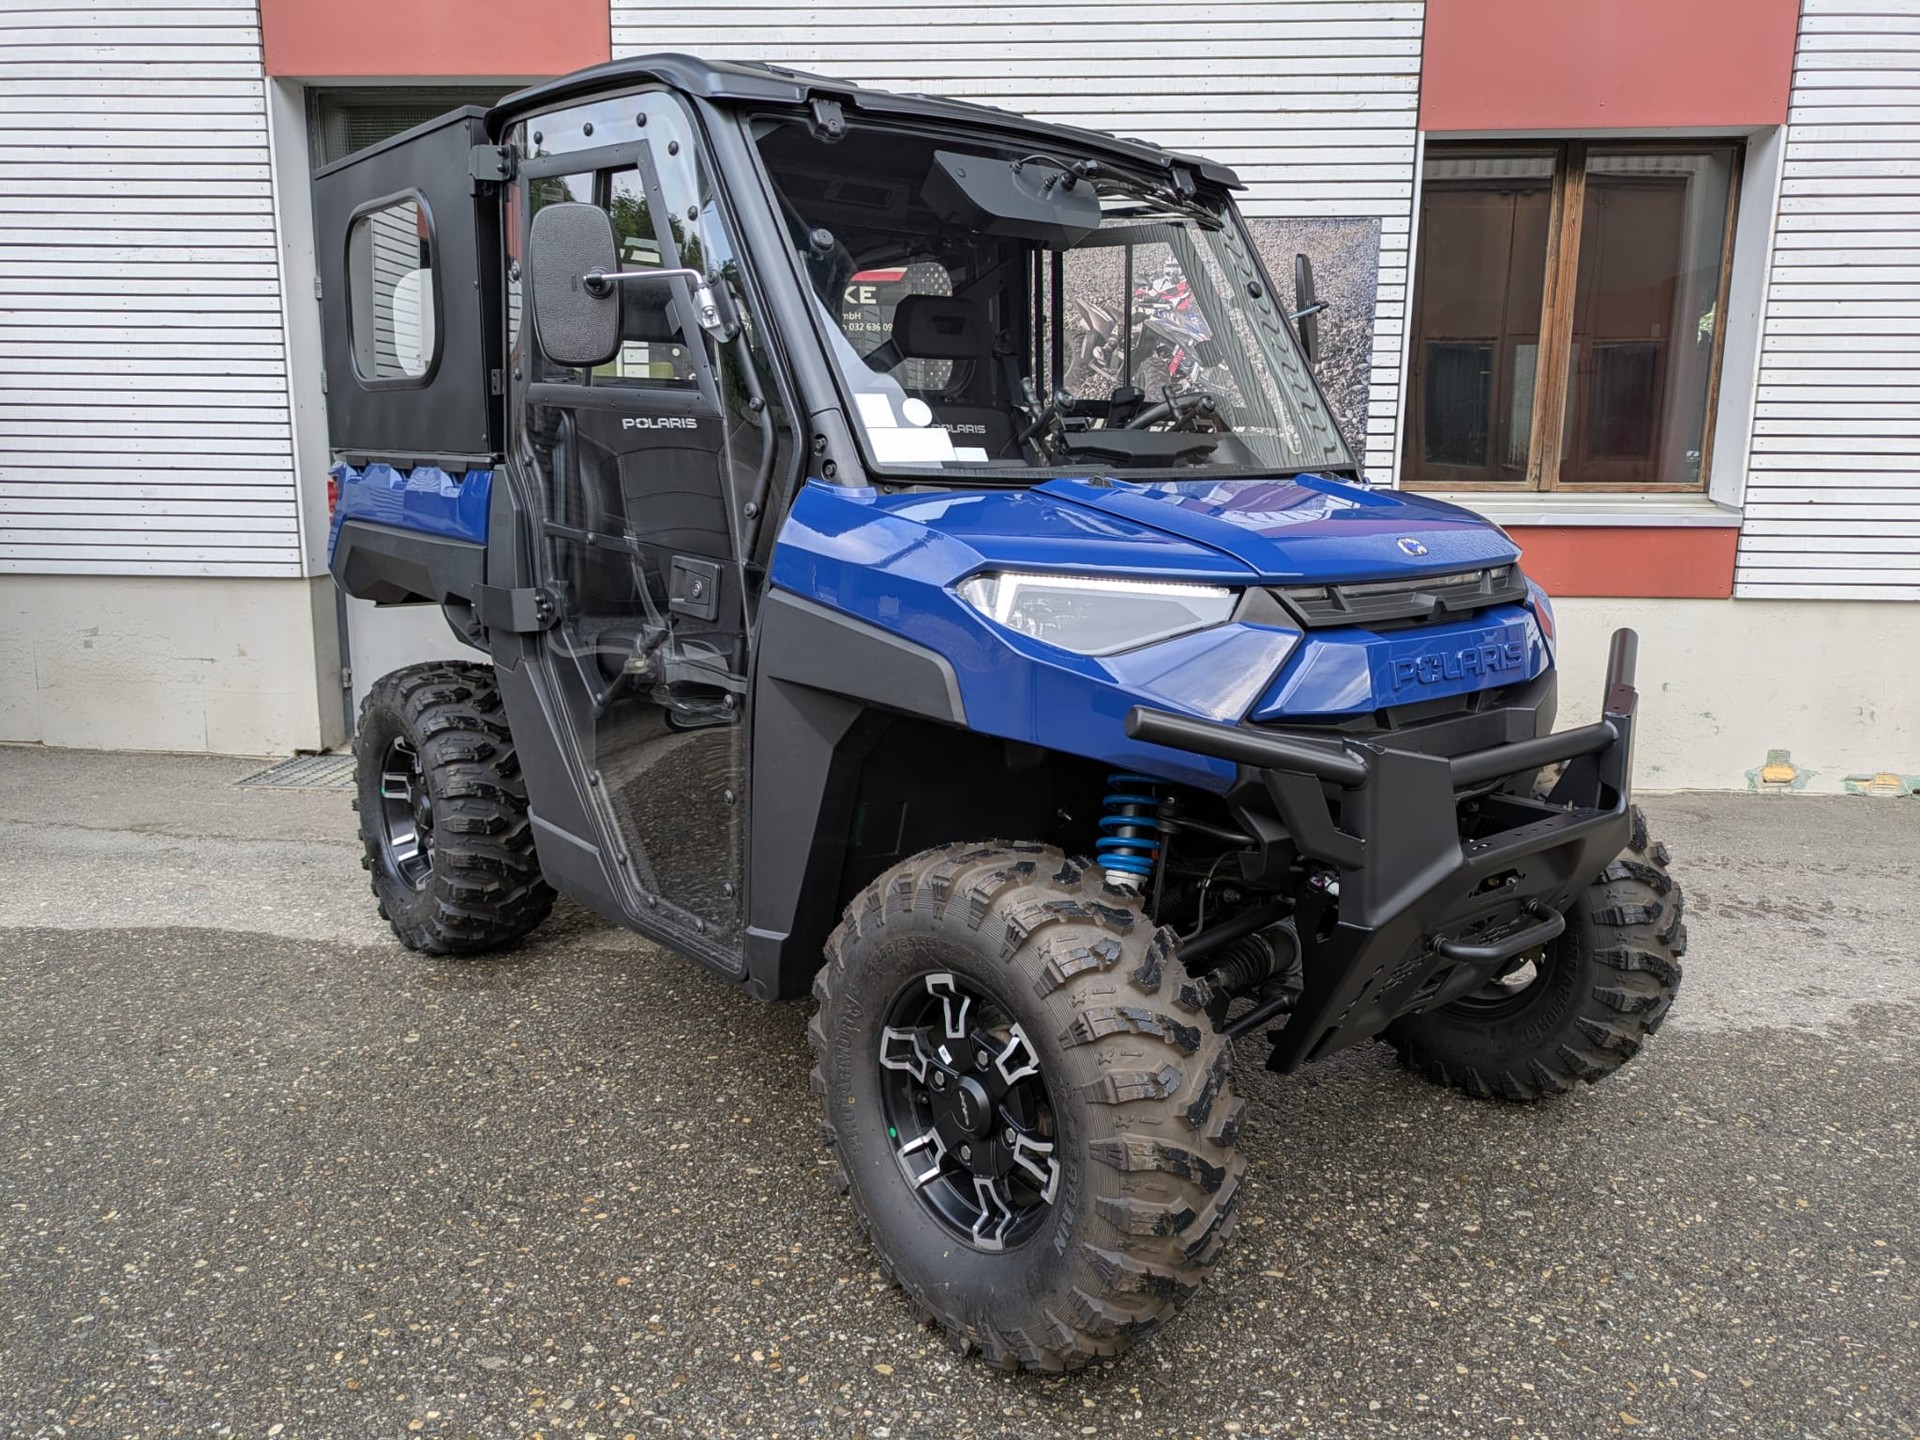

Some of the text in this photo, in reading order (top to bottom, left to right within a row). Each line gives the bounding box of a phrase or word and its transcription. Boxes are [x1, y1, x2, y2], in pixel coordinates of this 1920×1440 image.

[848, 322, 864, 332] 032
[866, 322, 881, 332] 636
[621, 417, 698, 430] POLARIS
[1388, 640, 1523, 690] POLARIS
